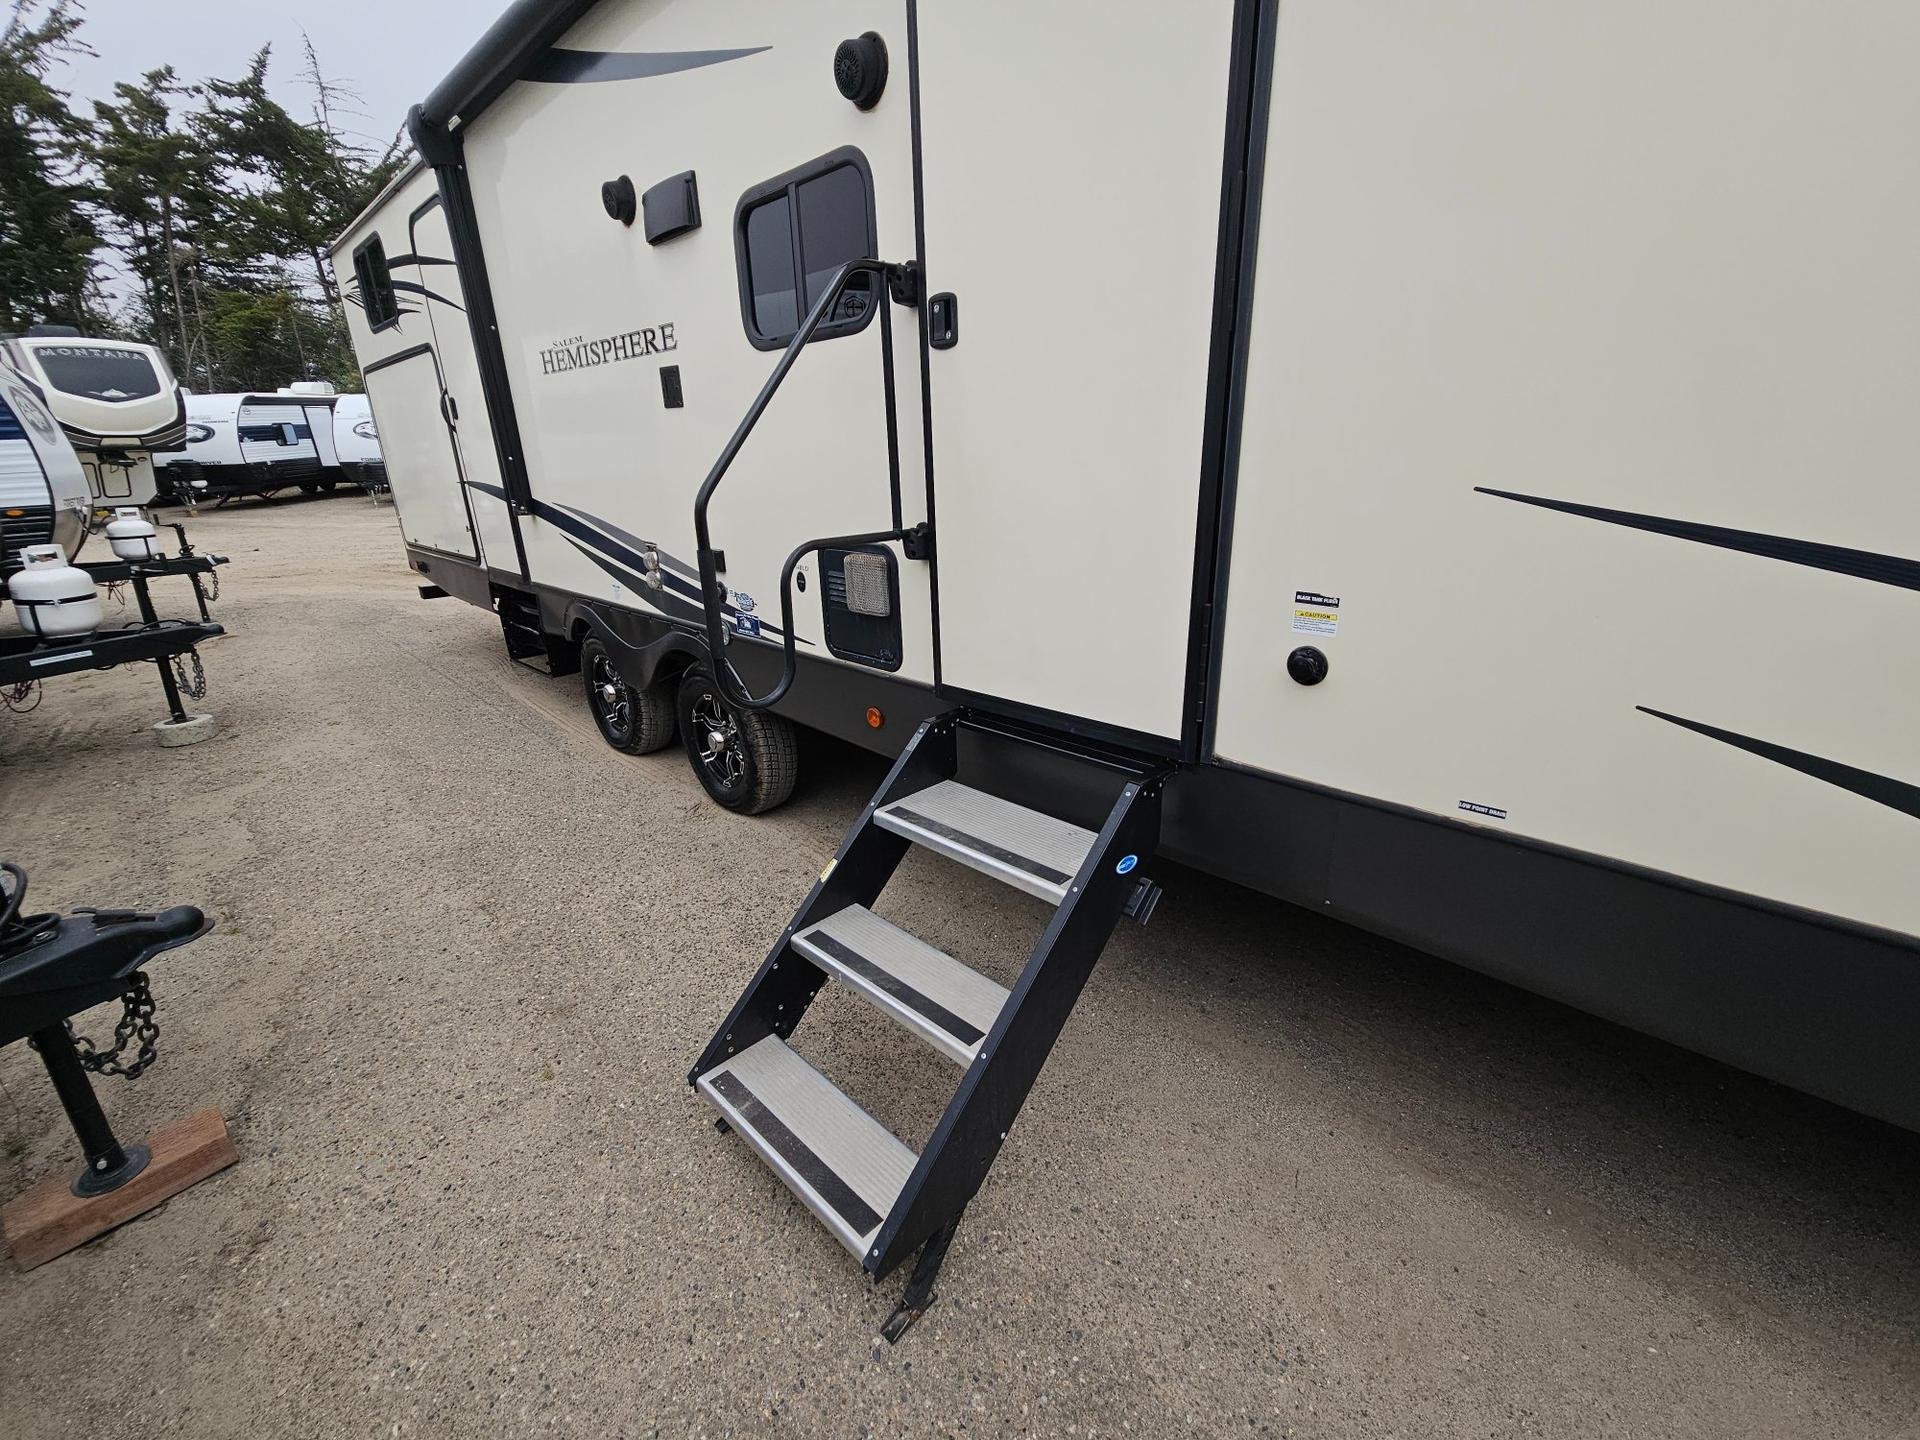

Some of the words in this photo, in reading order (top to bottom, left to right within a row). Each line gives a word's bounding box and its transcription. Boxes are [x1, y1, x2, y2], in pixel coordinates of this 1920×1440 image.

[540, 322, 678, 374] HEMISPHERE
[552, 335, 584, 349] SALEM
[40, 347, 146, 361] MONTANA
[1304, 611, 1331, 619] CAUTION
[1459, 801, 1471, 809] LOW
[1471, 804, 1489, 813] POINT
[1488, 808, 1506, 817] DRAIN
